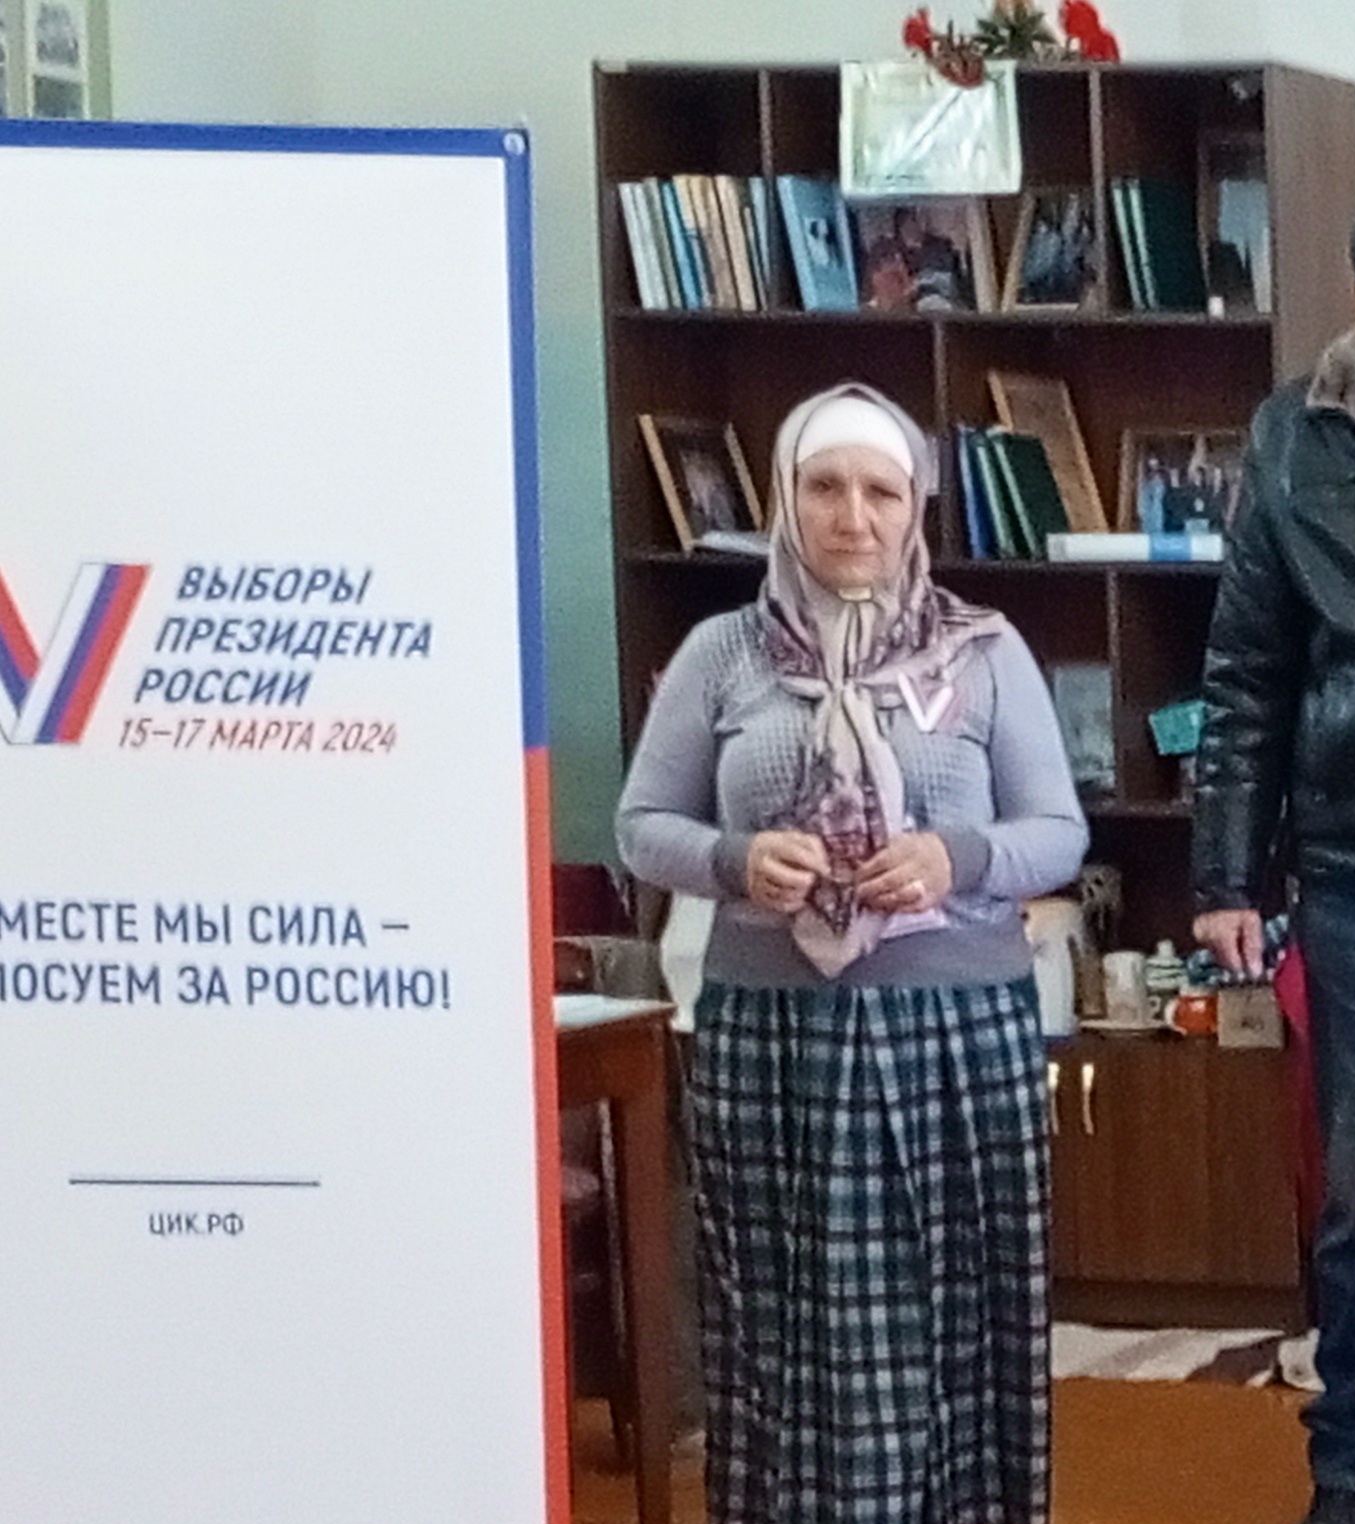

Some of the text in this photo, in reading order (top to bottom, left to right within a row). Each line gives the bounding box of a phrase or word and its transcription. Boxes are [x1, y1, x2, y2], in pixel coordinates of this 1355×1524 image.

[176, 564, 373, 605] ВЫБОРЫ
[154, 616, 433, 661] ПРЕЗИДЕНТА
[134, 668, 312, 706] РОССИИ
[209, 718, 315, 751] МАРТА
[321, 720, 397, 753] 2024
[154, 903, 232, 945] МЫ
[247, 904, 367, 947] СИЛА
[0, 962, 451, 1010] ОСУЕМ ЗА РОССИЮ!
[148, 1210, 245, 1238] ЦИК.РФ
